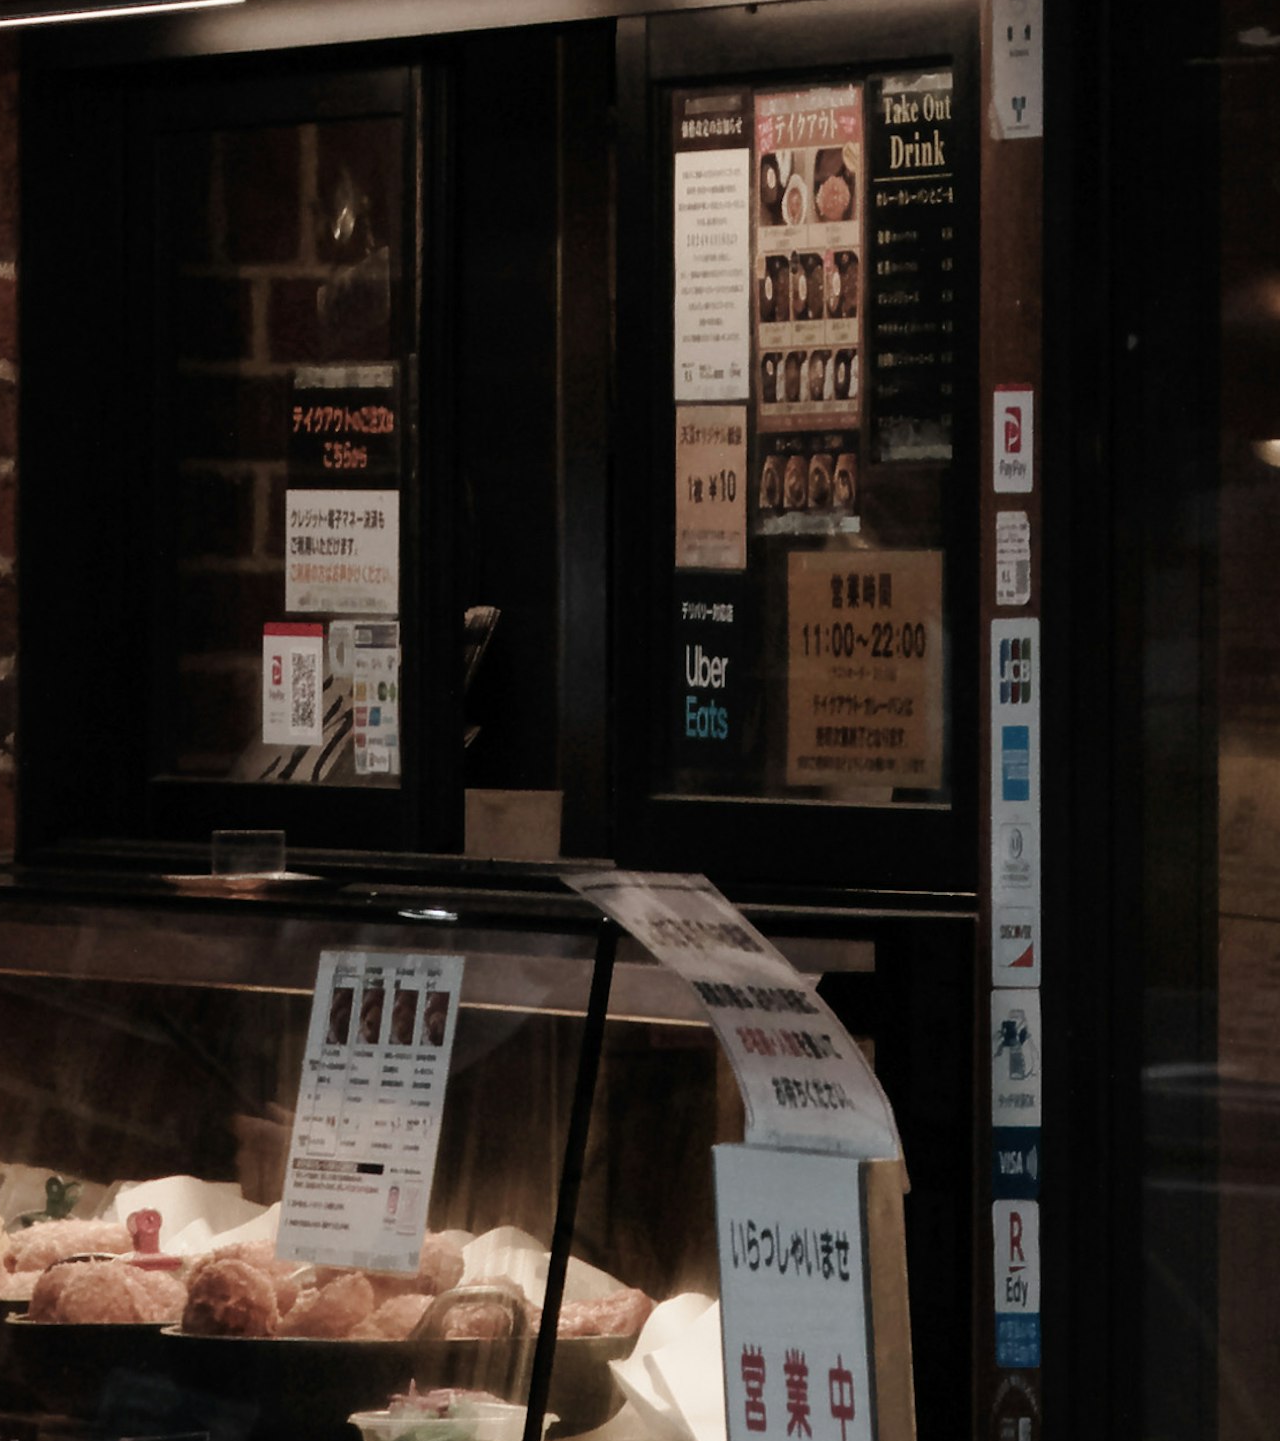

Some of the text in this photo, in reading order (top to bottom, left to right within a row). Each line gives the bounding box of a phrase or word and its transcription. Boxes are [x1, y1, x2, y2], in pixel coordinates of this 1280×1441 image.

[882, 93, 921, 125] Take
[923, 88, 952, 123] Out
[774, 108, 838, 144] テイクアウト
[889, 128, 946, 170] Drink
[322, 440, 368, 469] こちらから
[999, 457, 1028, 478] PayPay
[830, 573, 893, 610] 営業時間
[685, 643, 730, 688] Uber
[1000, 659, 1031, 683] JCB
[685, 694, 730, 741] Eats
[998, 1150, 1023, 1176] VISA
[731, 1217, 851, 1283] いらっしゃいませ
[1005, 1276, 1029, 1304] Edy
